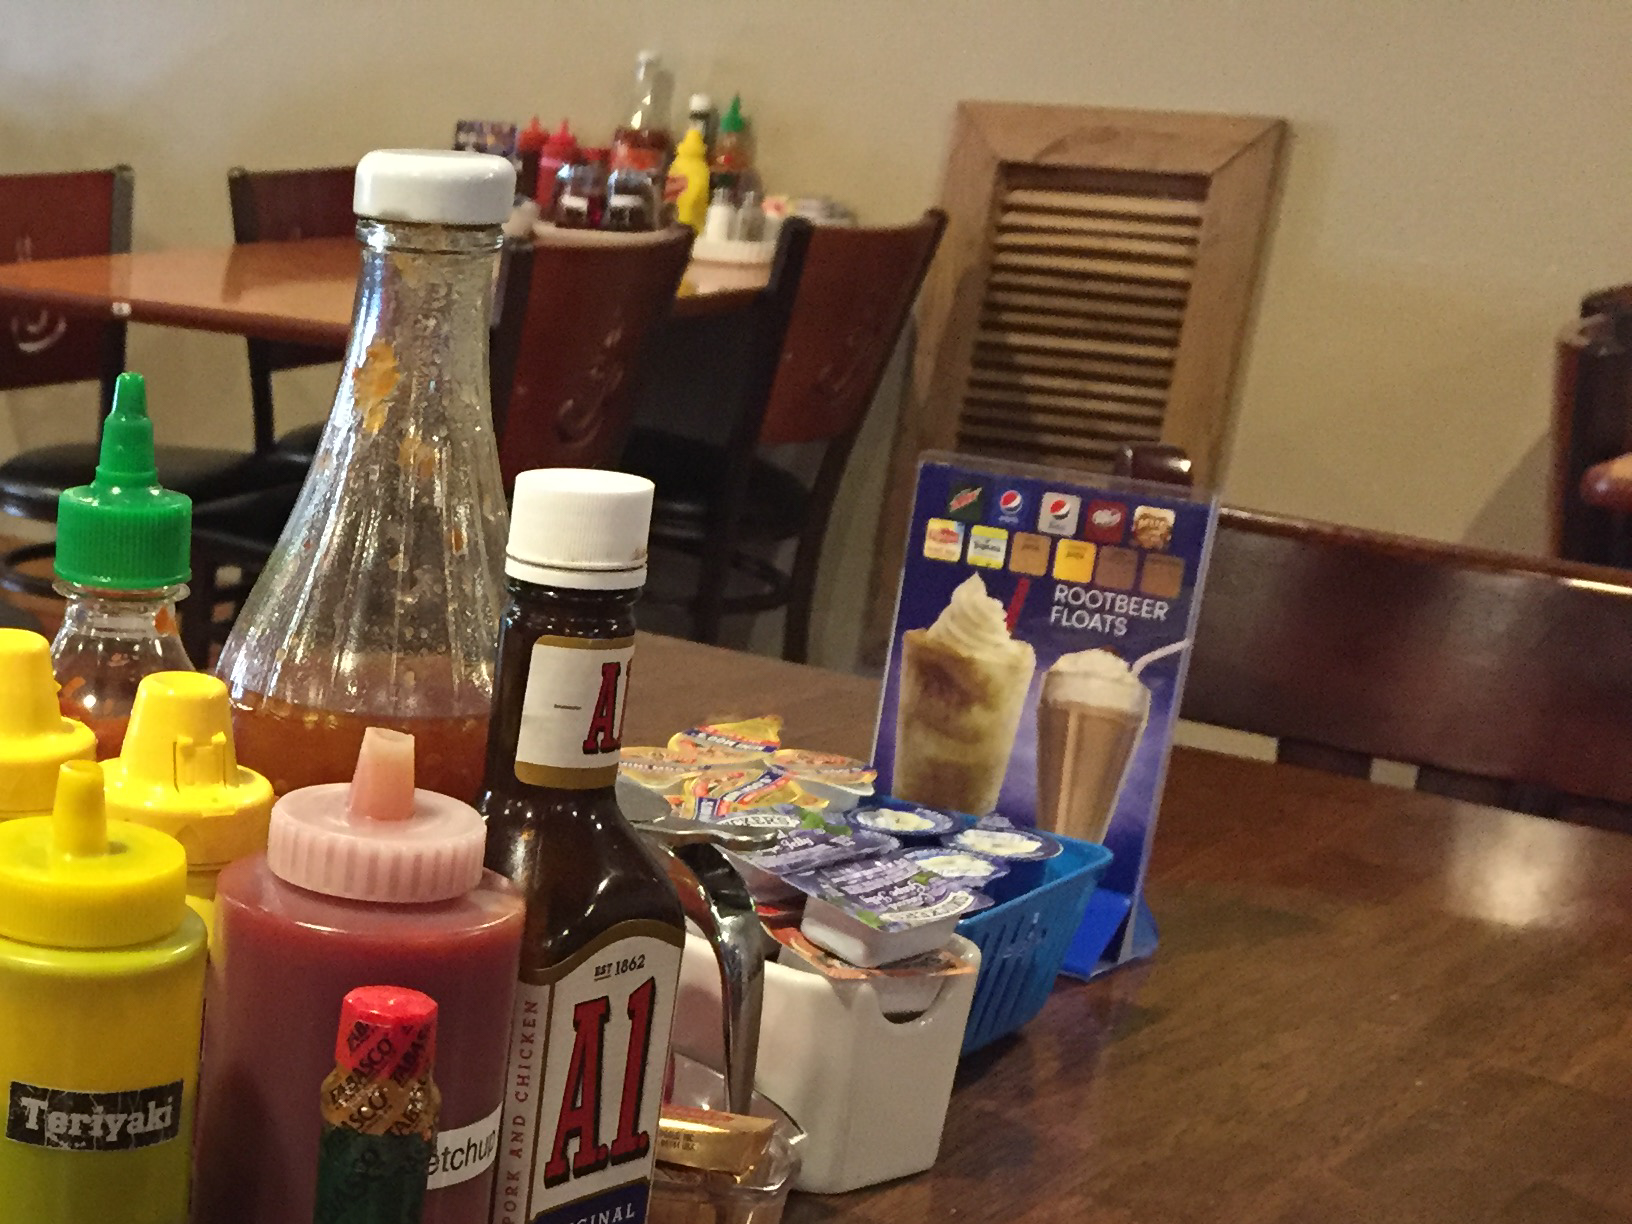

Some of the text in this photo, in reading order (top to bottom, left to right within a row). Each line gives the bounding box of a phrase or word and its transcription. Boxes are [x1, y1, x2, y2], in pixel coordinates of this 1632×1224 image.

[1049, 605, 1129, 637] FLOATS
[1054, 584, 1170, 622] ROOTBEER
[594, 954, 646, 977] EST 1862
[515, 1000, 539, 1103] CHICKEN
[20, 1096, 173, 1141] Teriyaki
[511, 1114, 526, 1159] AND
